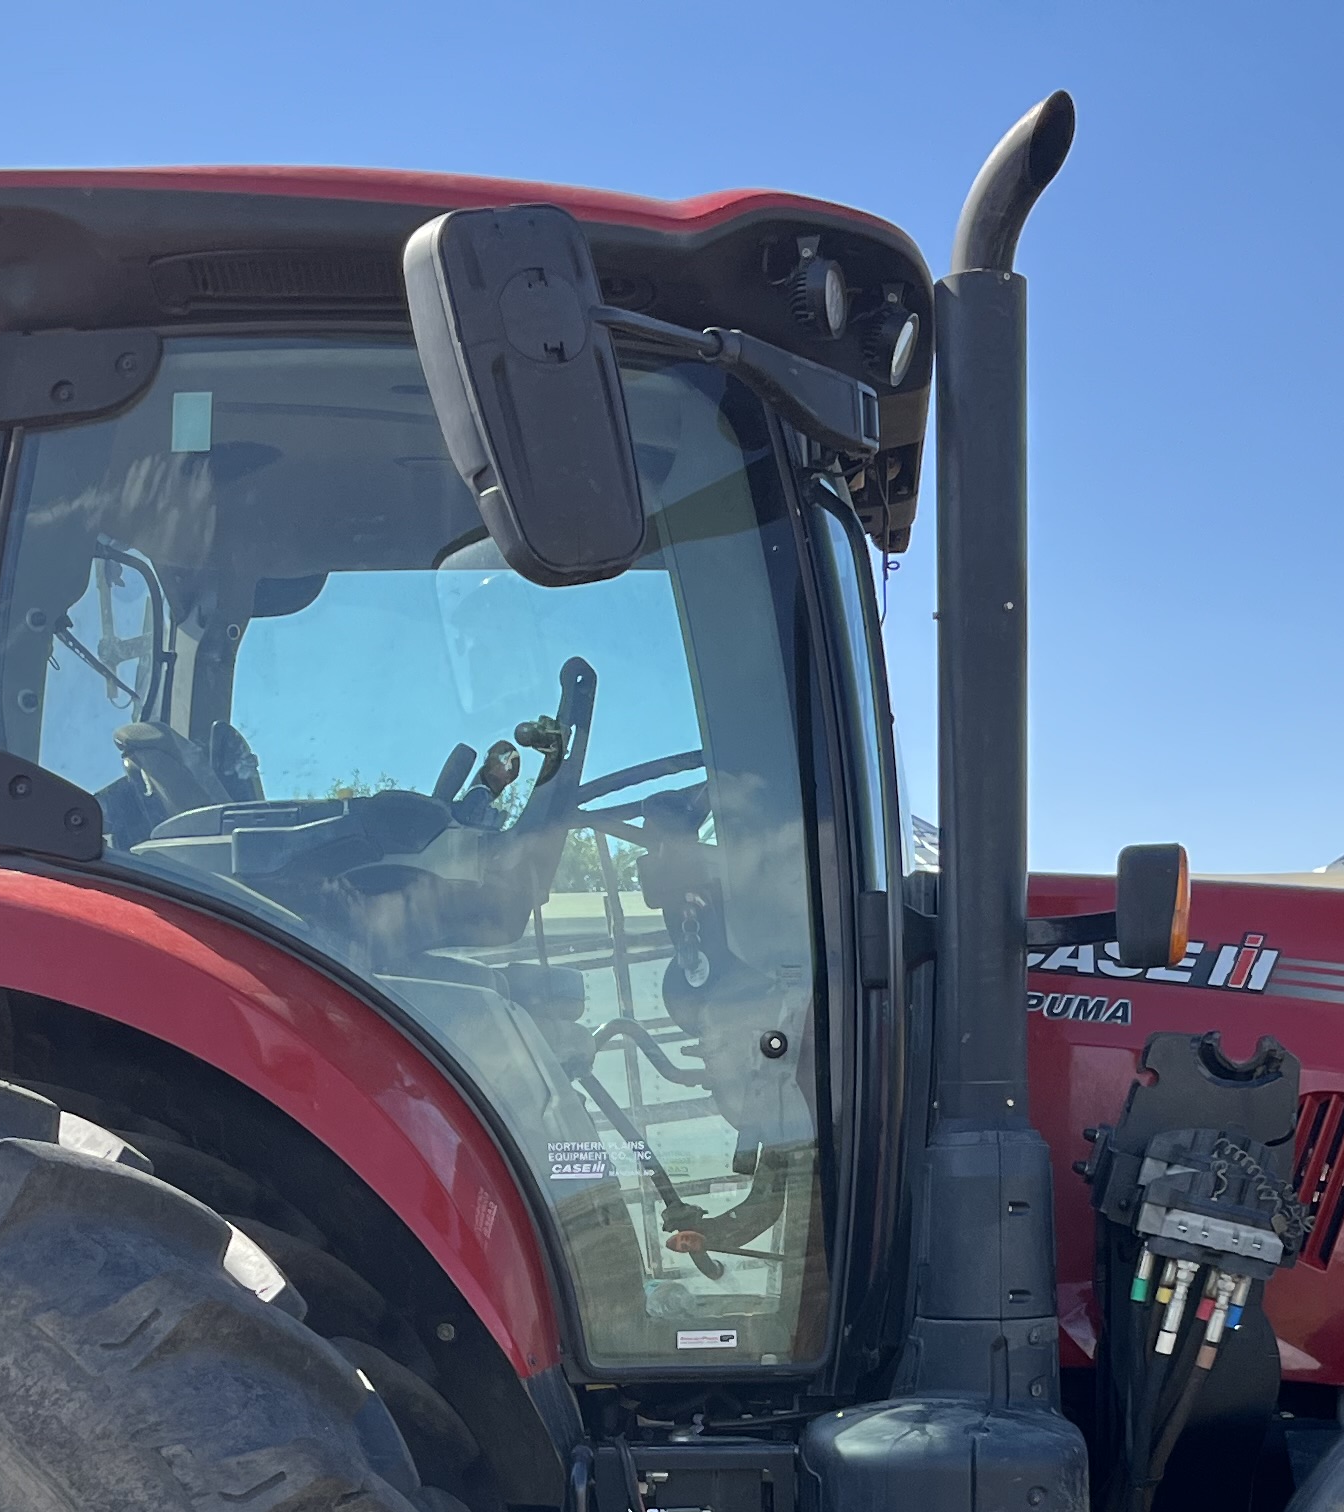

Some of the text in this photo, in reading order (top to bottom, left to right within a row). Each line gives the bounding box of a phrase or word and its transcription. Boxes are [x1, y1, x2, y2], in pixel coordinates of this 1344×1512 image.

[1027, 991, 1133, 1026] PUMA
[547, 1141, 606, 1152] NORTHERN
[548, 1151, 607, 1162] EQUIPMENT
